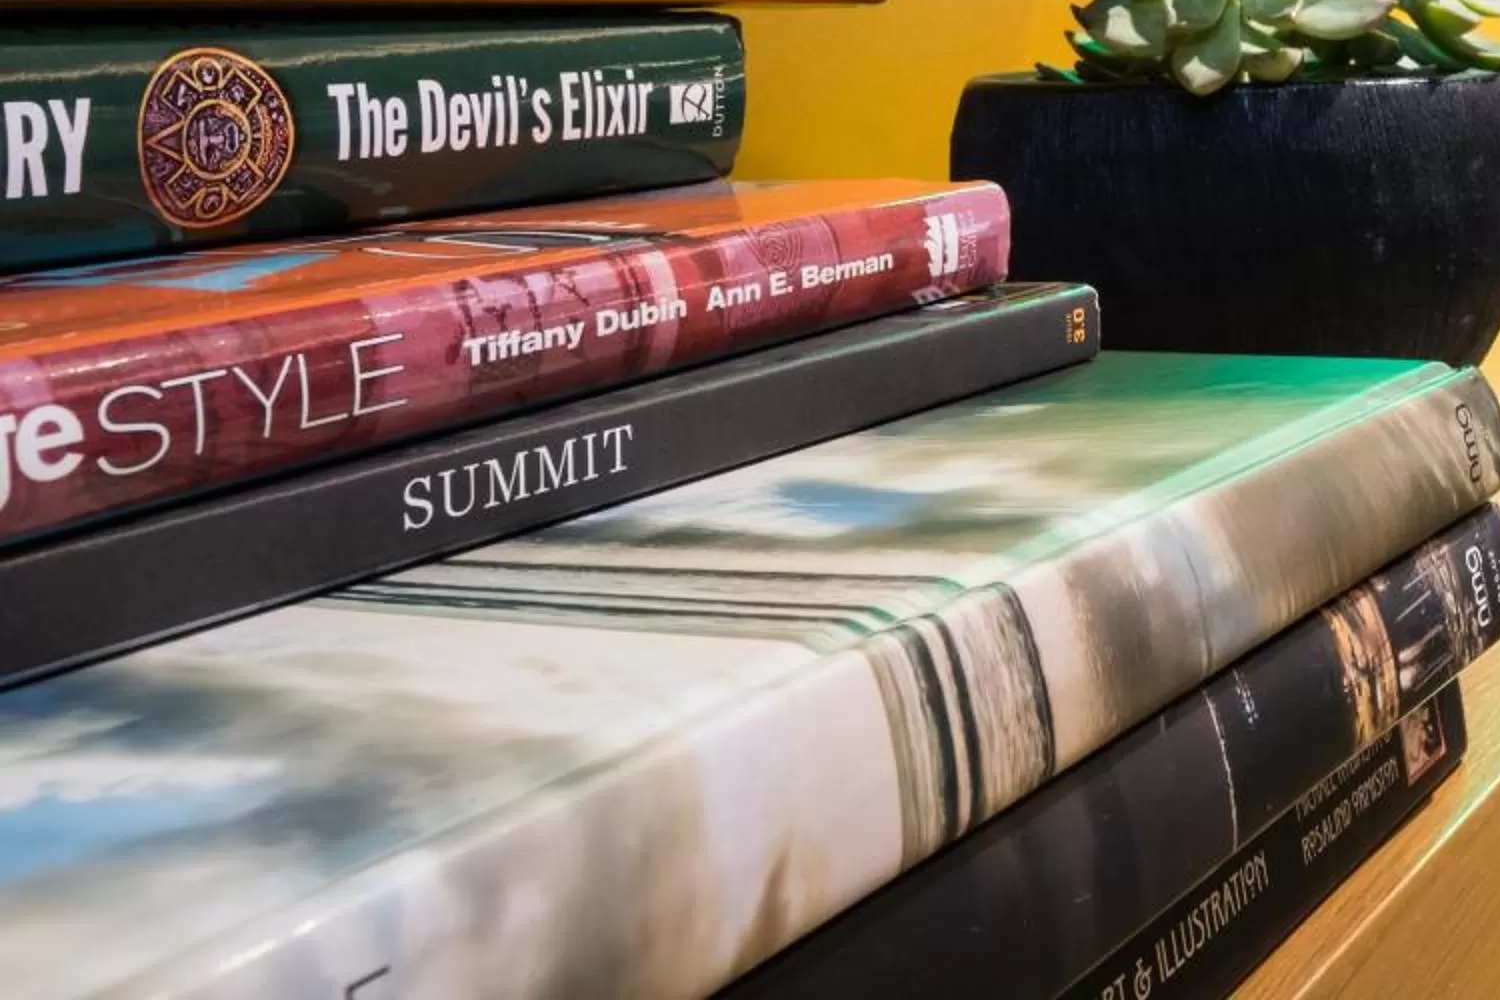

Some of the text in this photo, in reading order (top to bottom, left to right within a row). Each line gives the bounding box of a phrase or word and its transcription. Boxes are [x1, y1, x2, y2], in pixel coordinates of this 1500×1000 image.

[326, 81, 409, 161] The
[416, 74, 552, 154] Devil's
[559, 68, 654, 141] Elixir
[711, 64, 725, 137] DUTTON
[97, 333, 409, 476] STYLE
[462, 318, 586, 367] Tiffany
[595, 296, 688, 337] Dubin
[706, 283, 761, 313] Ann
[768, 269, 794, 298] E.
[800, 251, 894, 290] Berman
[402, 423, 634, 532] SUMMIT
[1154, 849, 1270, 984] ILLUSTRATION
